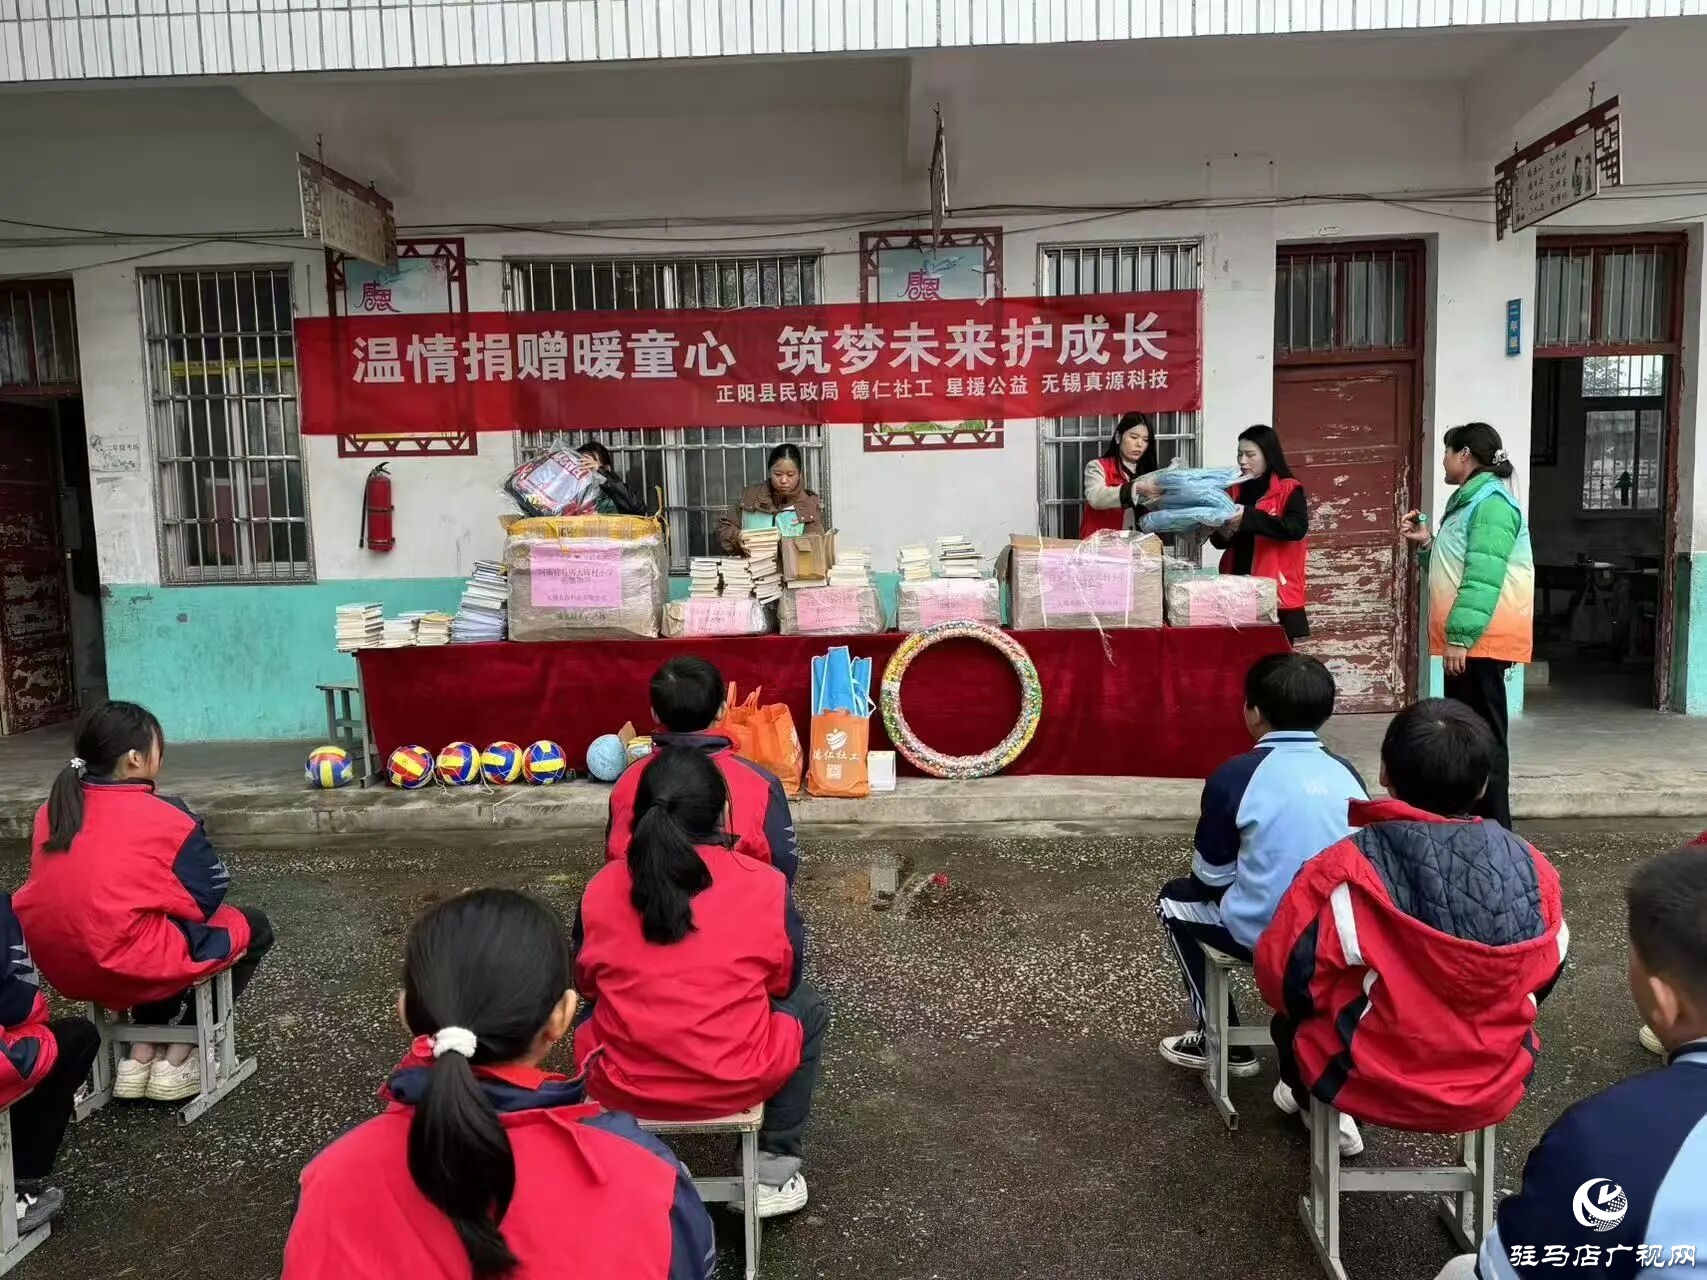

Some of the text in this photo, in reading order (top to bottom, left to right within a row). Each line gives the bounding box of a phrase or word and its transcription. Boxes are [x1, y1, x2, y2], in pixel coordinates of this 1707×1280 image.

[352, 312, 1169, 383] 温情捐赠暖童心 筑梦未来护成长
[716, 369, 1169, 403] 正阳县民政局 德仁社工 星援公益 无锡真源科技
